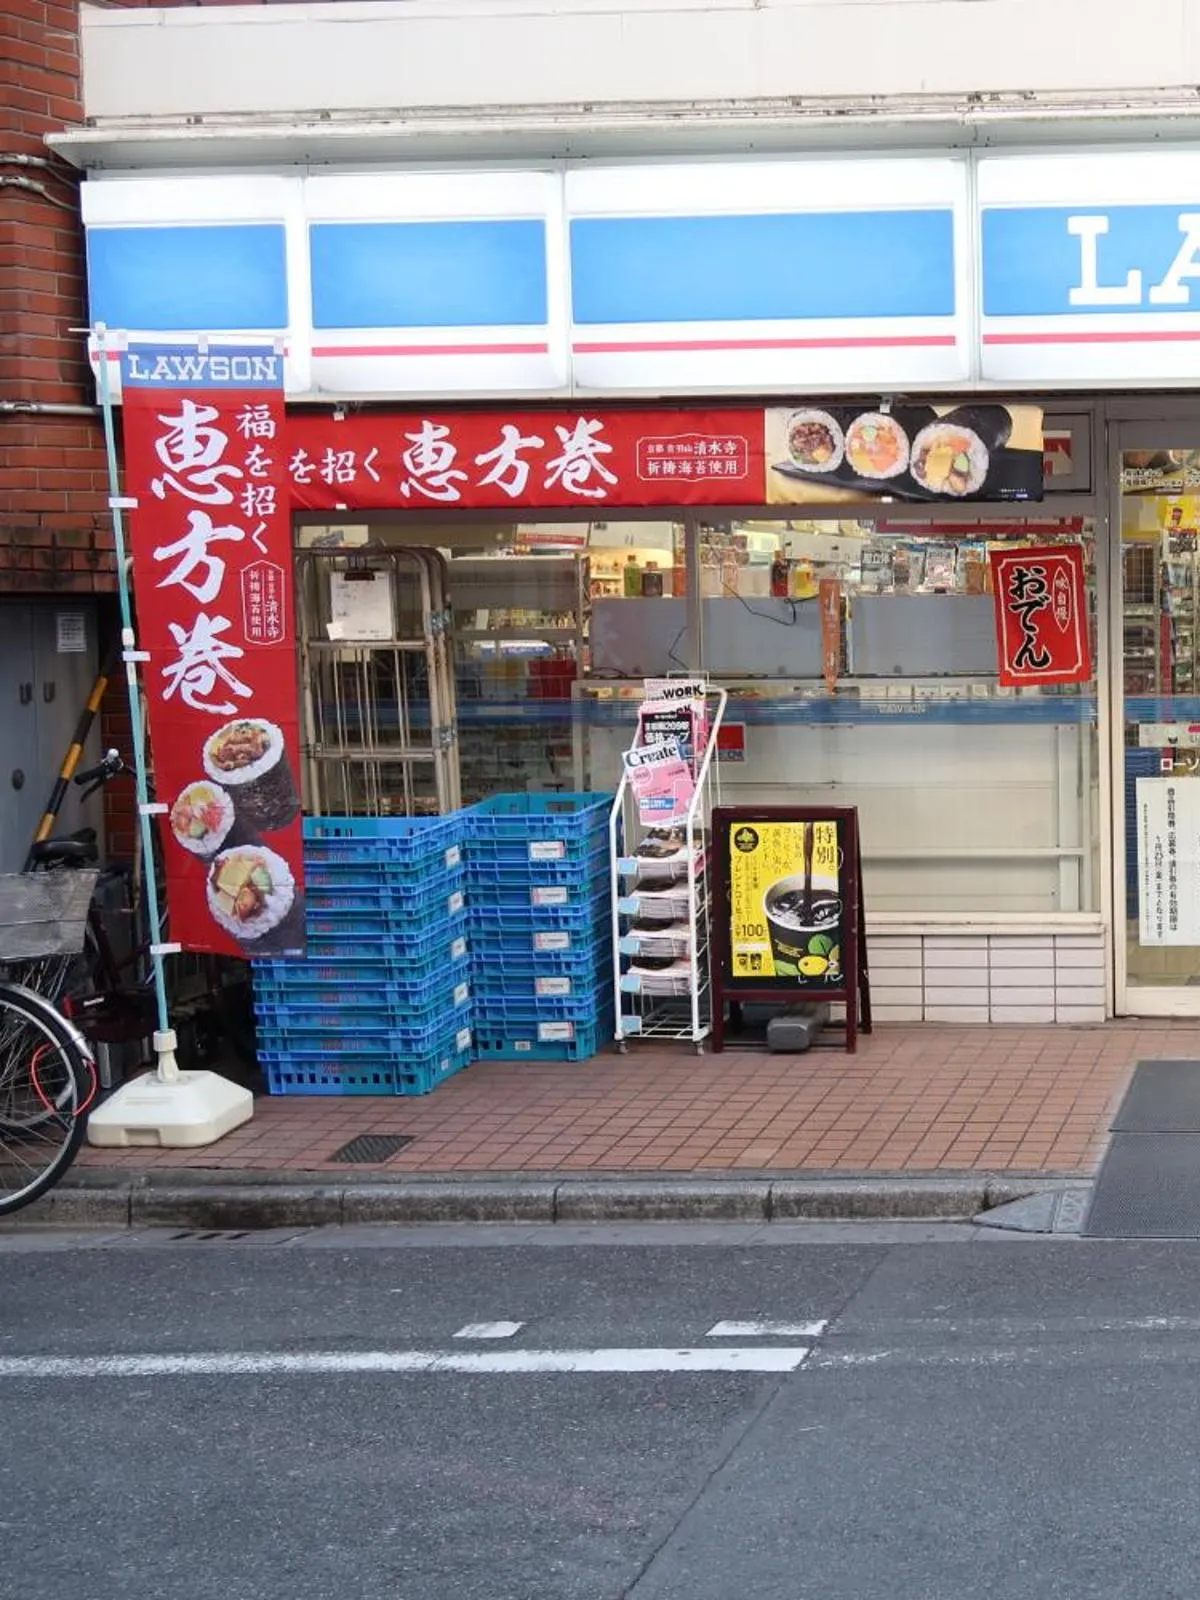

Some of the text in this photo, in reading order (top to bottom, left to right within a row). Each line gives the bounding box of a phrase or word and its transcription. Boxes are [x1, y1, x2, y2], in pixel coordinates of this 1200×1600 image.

[128, 355, 277, 381] LAWSON
[288, 448, 380, 484] を招く
[399, 418, 619, 501] 恵方巻
[236, 404, 277, 554] 福を招く
[151, 399, 254, 717] 恵方巻
[1009, 566, 1051, 669] おでん
[663, 684, 704, 699] WORK
[626, 745, 678, 768] Create
[742, 924, 763, 937] 100
